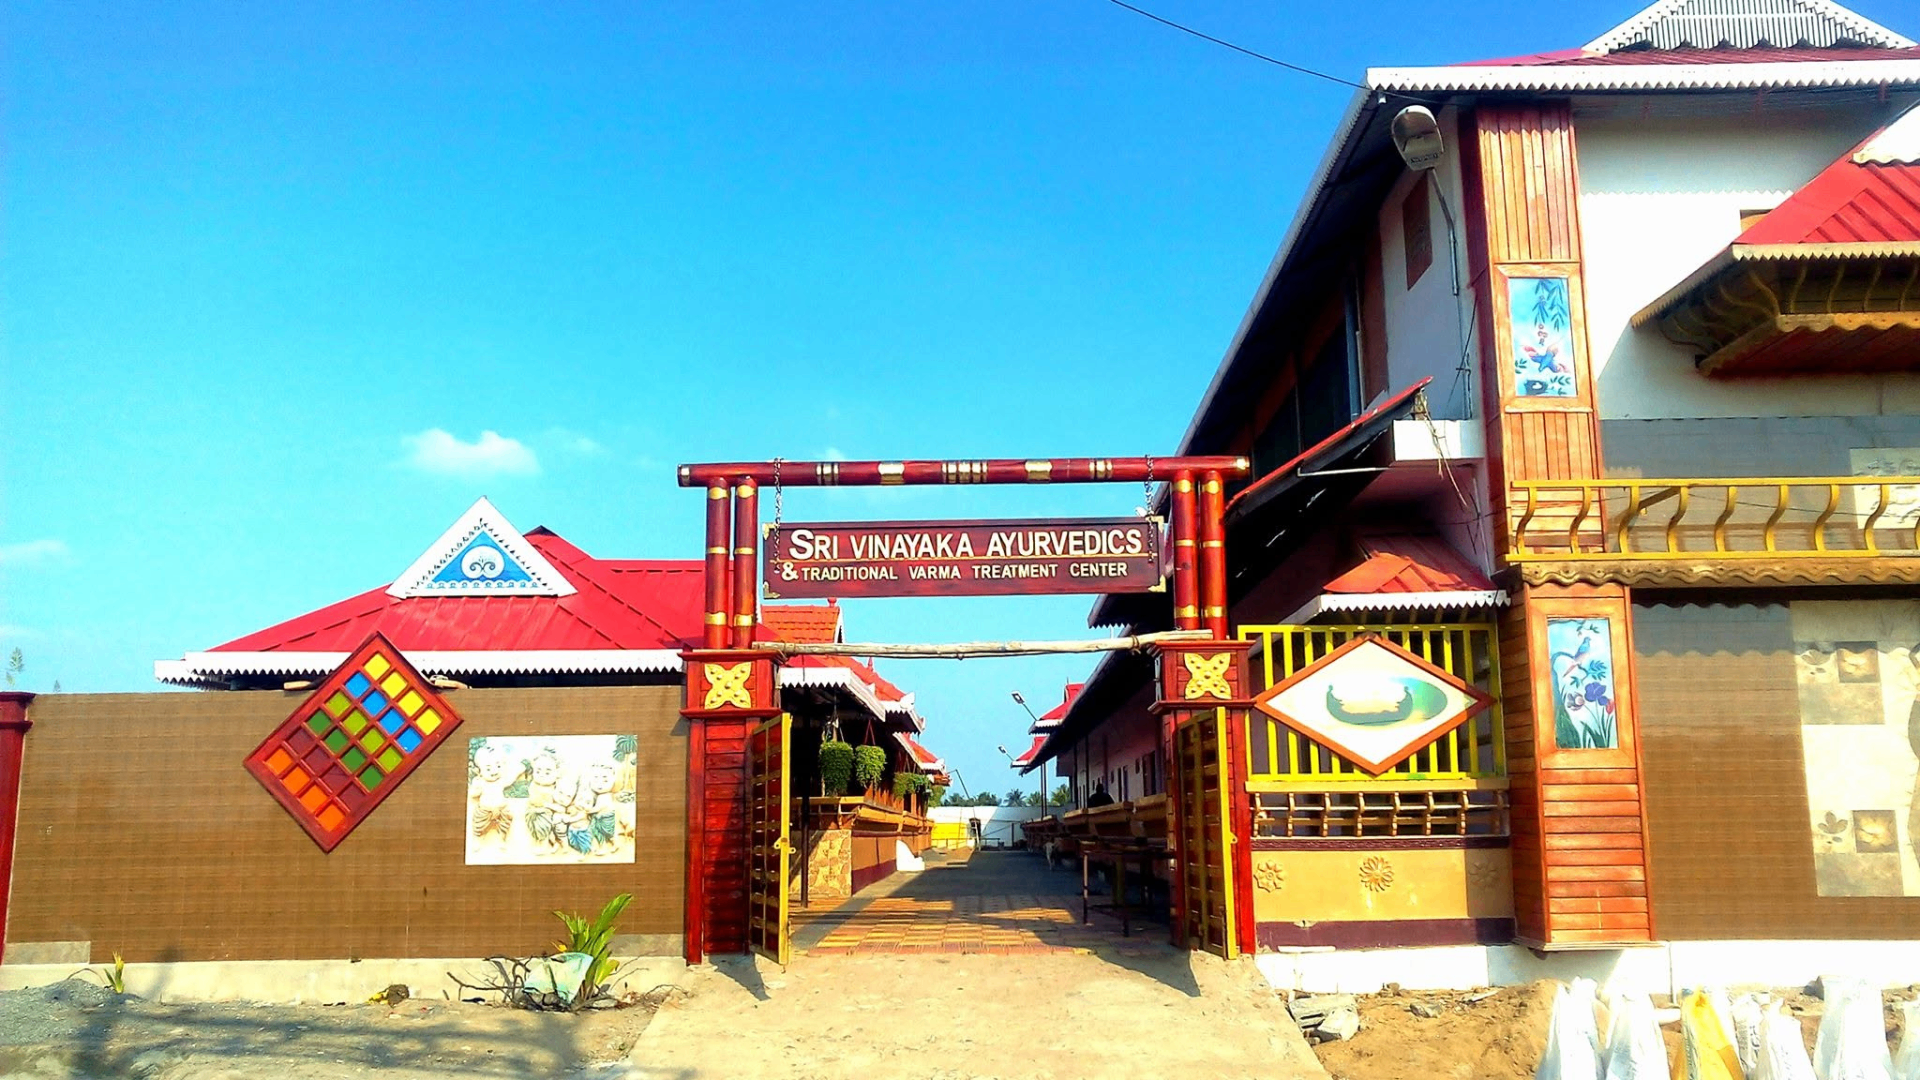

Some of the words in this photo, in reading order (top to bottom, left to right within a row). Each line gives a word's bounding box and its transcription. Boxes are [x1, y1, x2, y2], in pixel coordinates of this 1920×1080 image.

[849, 532, 975, 559] VINAYAKA
[985, 529, 1142, 556] AYURVEDICS
[781, 561, 799, 581] &
[801, 566, 898, 581] TRADITIONAL
[909, 565, 962, 580] VARMA
[972, 563, 1059, 579] TREATMENT
[1070, 562, 1128, 577] CENTER
